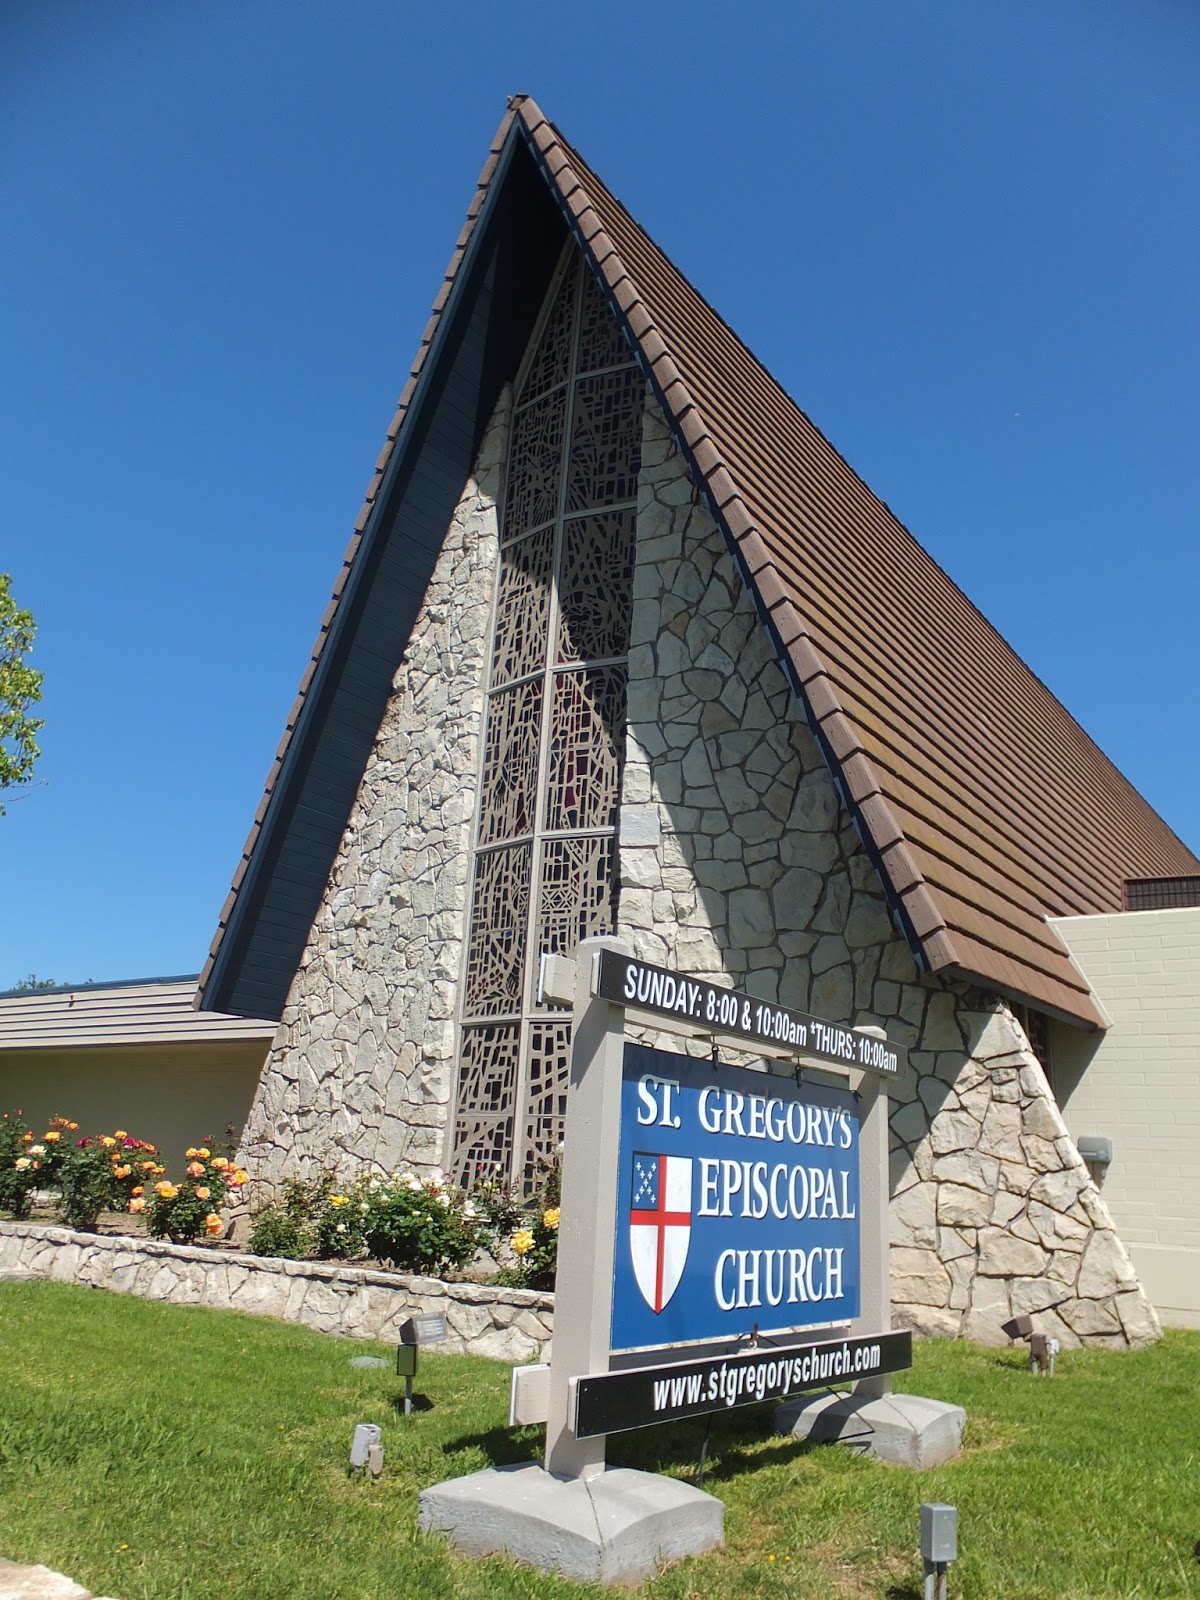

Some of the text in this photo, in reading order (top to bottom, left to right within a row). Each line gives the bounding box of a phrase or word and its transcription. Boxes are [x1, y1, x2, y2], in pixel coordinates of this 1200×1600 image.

[623, 964, 704, 1017] SUNDAY:
[706, 989, 739, 1027] 8:00
[741, 1000, 752, 1031] &
[755, 1004, 808, 1047] 10:00am
[858, 1041, 898, 1073] 10:00am
[637, 1074, 852, 1149] ST. GREGORY'S
[697, 1157, 856, 1220] EPISCOPAL
[714, 1246, 845, 1311] CHURCH
[653, 1342, 882, 1411] www.stgregoryschurch.com
